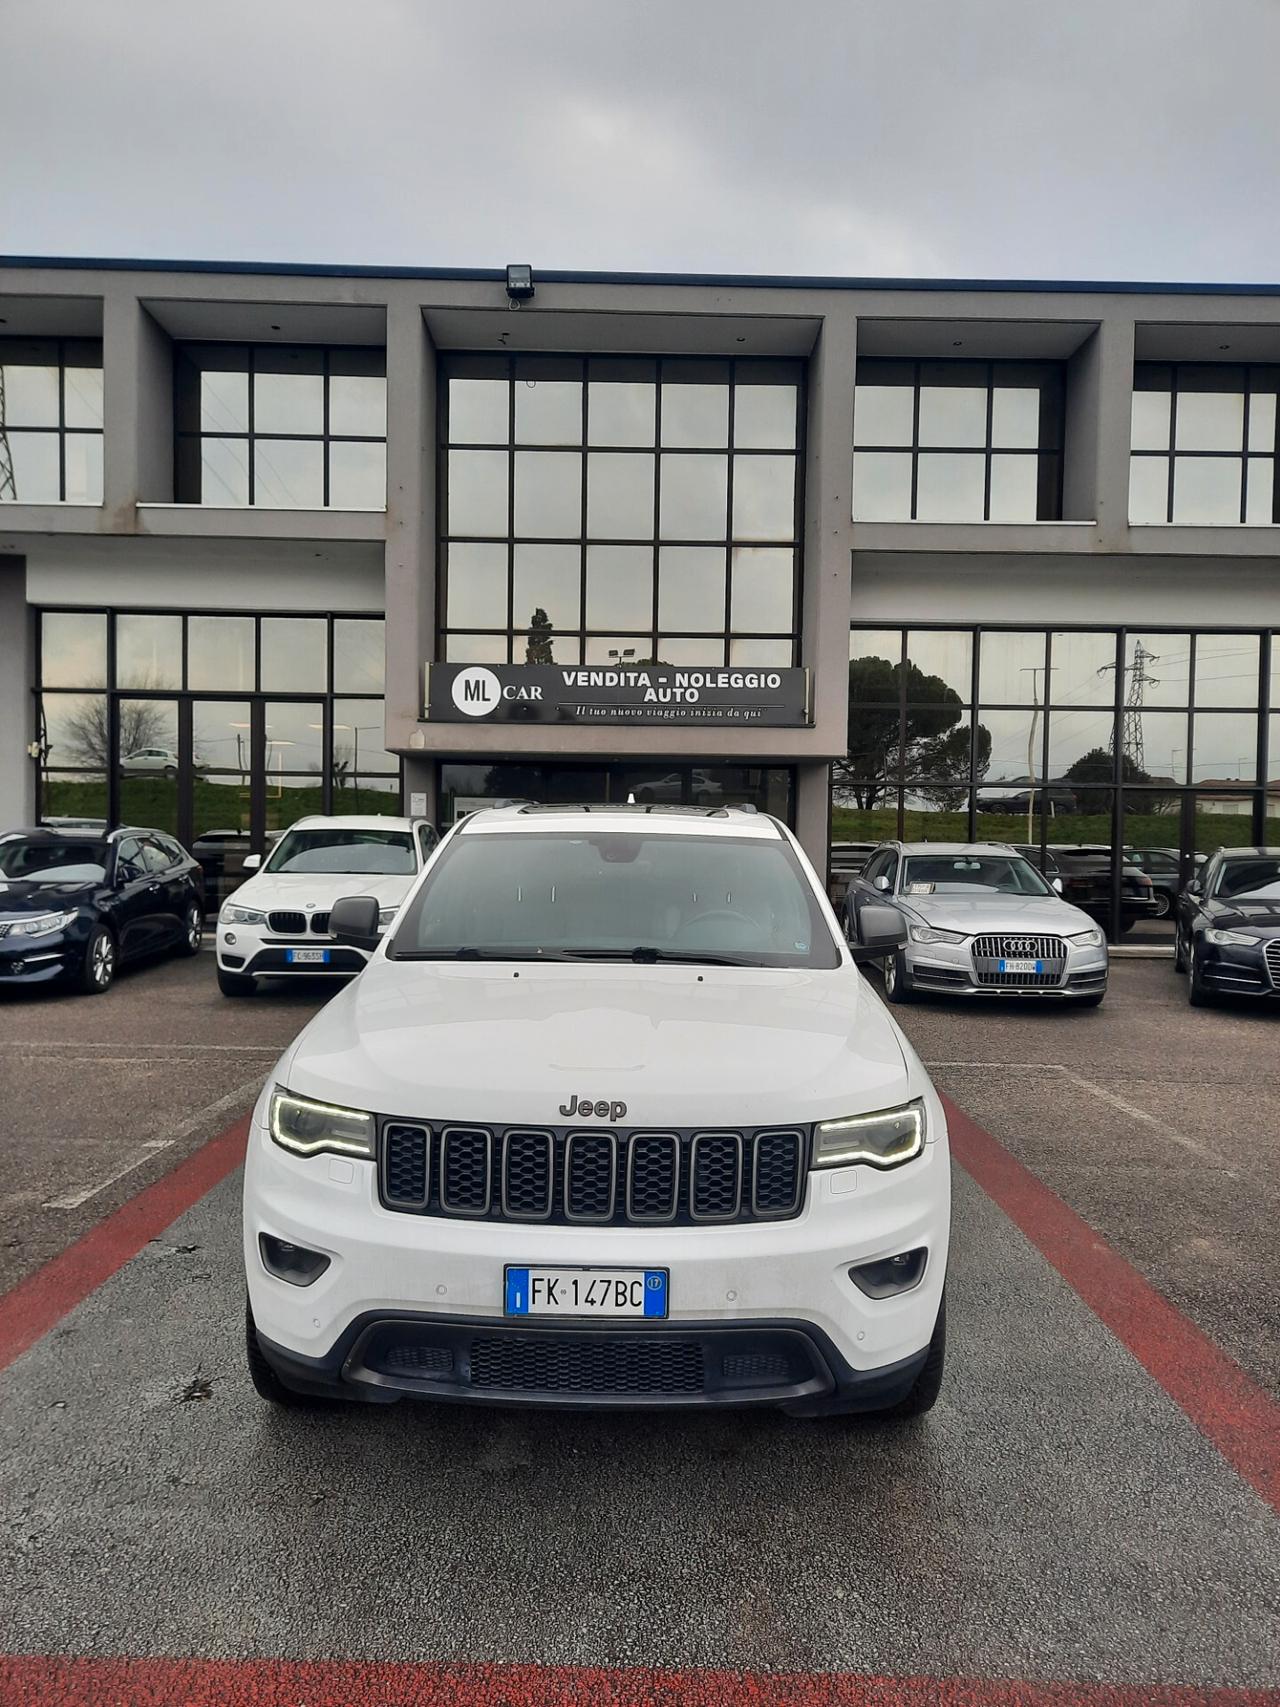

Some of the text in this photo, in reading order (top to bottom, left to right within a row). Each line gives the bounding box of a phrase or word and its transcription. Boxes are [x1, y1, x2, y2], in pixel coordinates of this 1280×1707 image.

[562, 671, 651, 687] VENDITA
[675, 672, 782, 689] NOLEGGIO
[464, 679, 543, 702] ML CAR
[643, 687, 700, 703] AUTO
[576, 705, 586, 716] Il
[589, 707, 607, 717] tuo
[610, 707, 643, 717] nuovo
[646, 706, 686, 720] viaggio
[690, 707, 723, 718] inizia
[727, 708, 740, 718] da
[559, 1095, 627, 1122] Jeep
[531, 1277, 560, 1306] FK
[572, 1278, 643, 1308] 147BC
